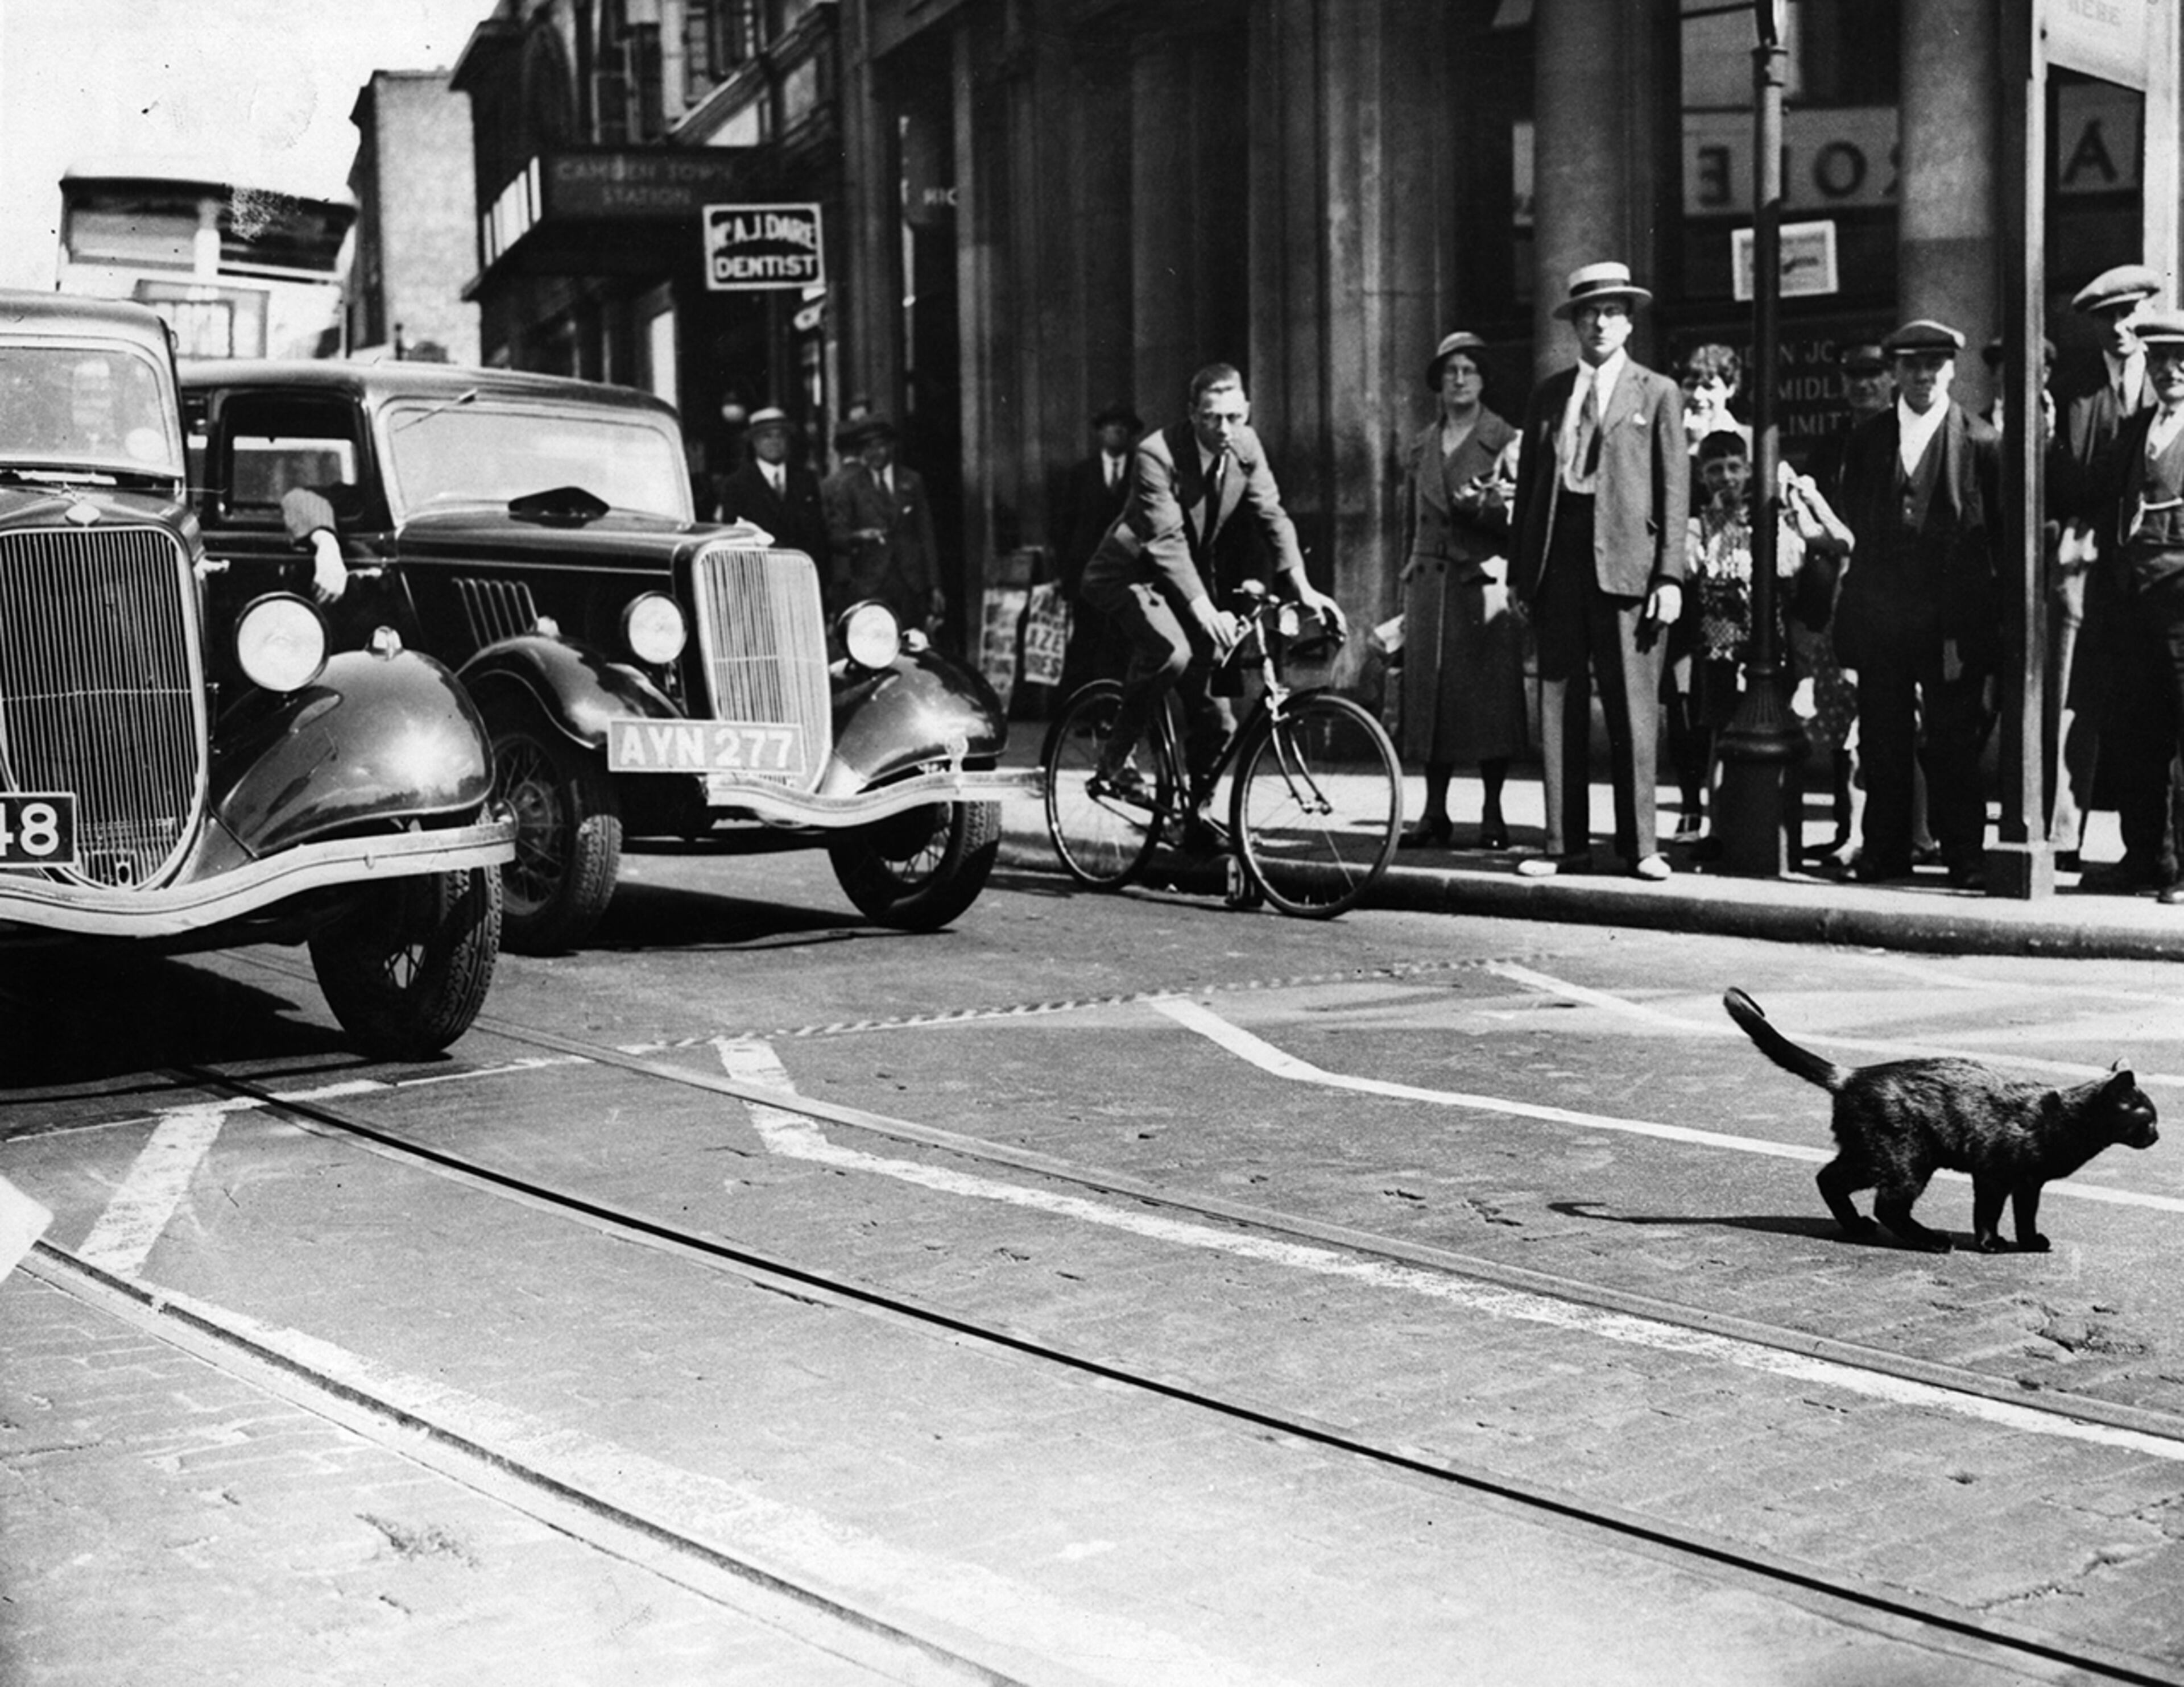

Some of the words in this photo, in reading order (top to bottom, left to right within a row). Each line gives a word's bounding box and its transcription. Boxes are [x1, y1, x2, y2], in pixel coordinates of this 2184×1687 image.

[603, 186, 692, 205] STATION
[715, 255, 816, 279] DENTIST
[620, 725, 706, 766] AYN
[714, 728, 793, 768] 277
